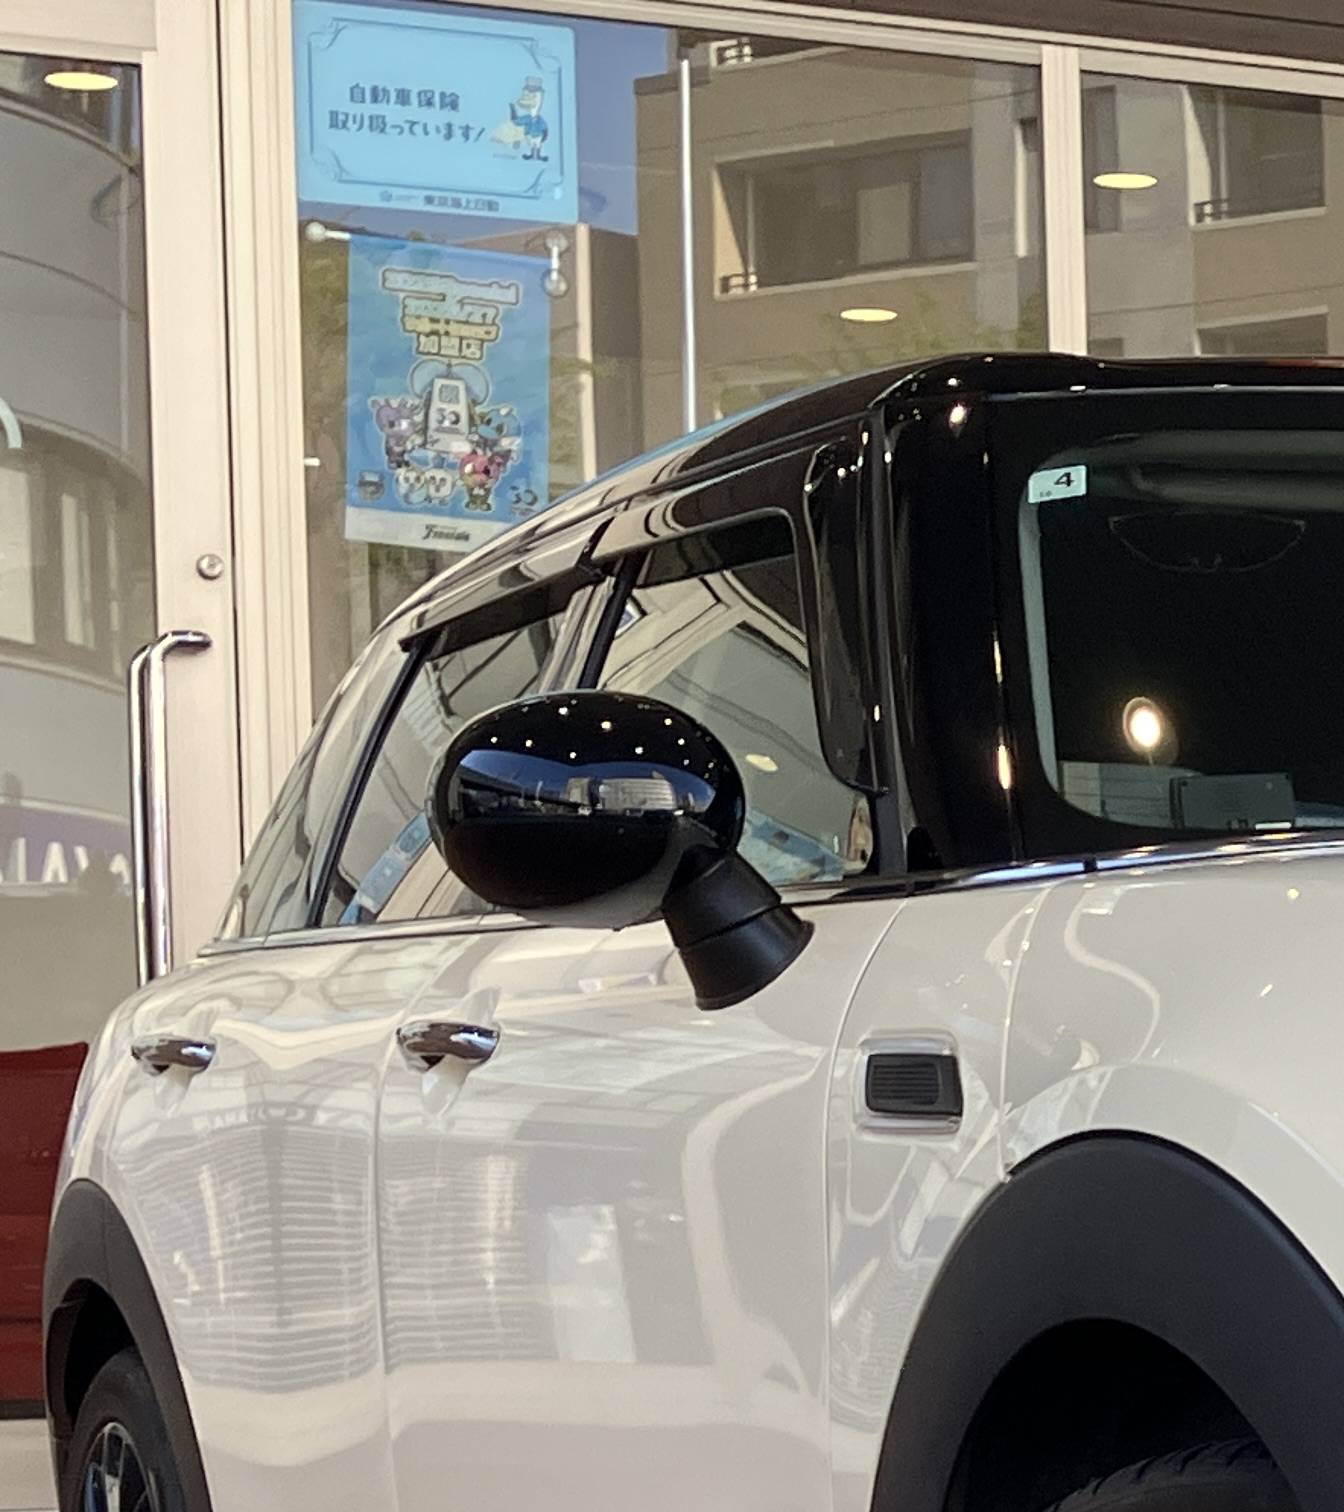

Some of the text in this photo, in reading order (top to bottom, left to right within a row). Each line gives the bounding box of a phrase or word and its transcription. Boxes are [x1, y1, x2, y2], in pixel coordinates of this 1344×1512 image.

[349, 83, 460, 112] 自動車保険
[1054, 471, 1075, 487] 4
